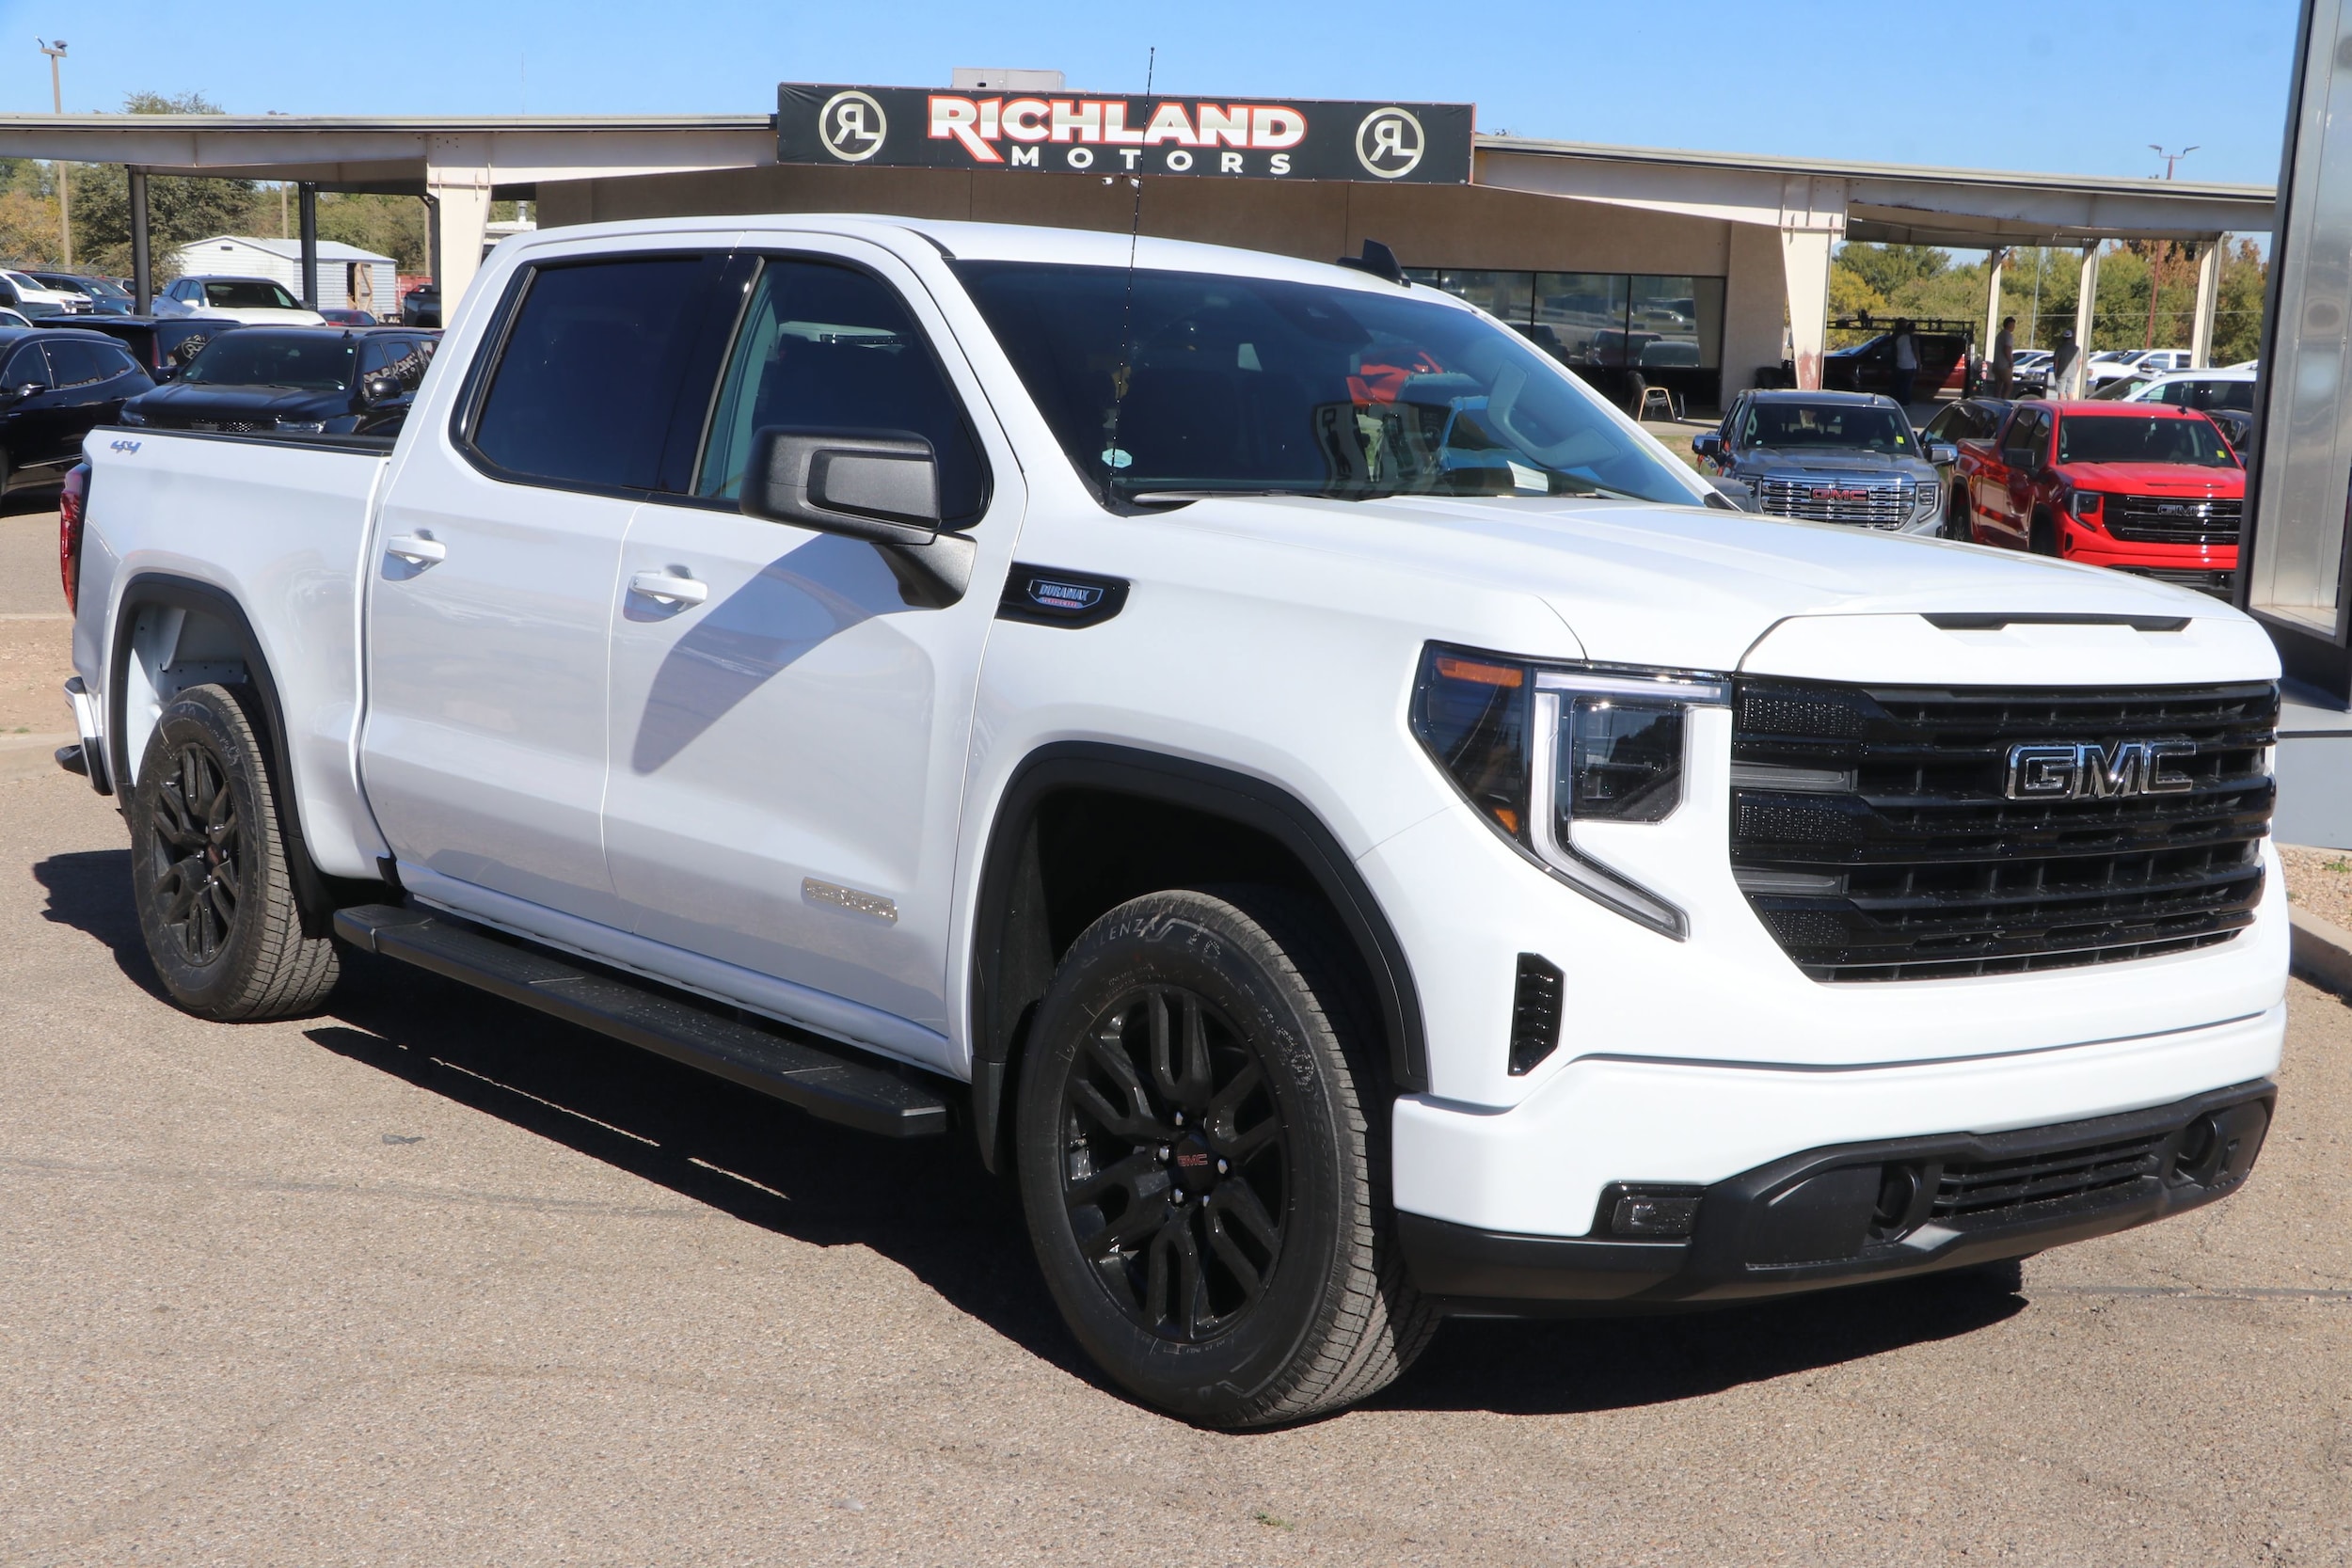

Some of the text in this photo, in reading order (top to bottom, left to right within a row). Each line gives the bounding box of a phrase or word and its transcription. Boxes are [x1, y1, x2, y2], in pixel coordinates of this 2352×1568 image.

[928, 95, 1309, 163] RICHLAND
[1010, 145, 1291, 176] MOTORS
[1812, 488, 1867, 501] GMC
[2157, 504, 2213, 517] GMC
[1039, 584, 1089, 601] DURAMAX
[2003, 739, 2197, 800] GMC
[1177, 1153, 1209, 1167] GMC
